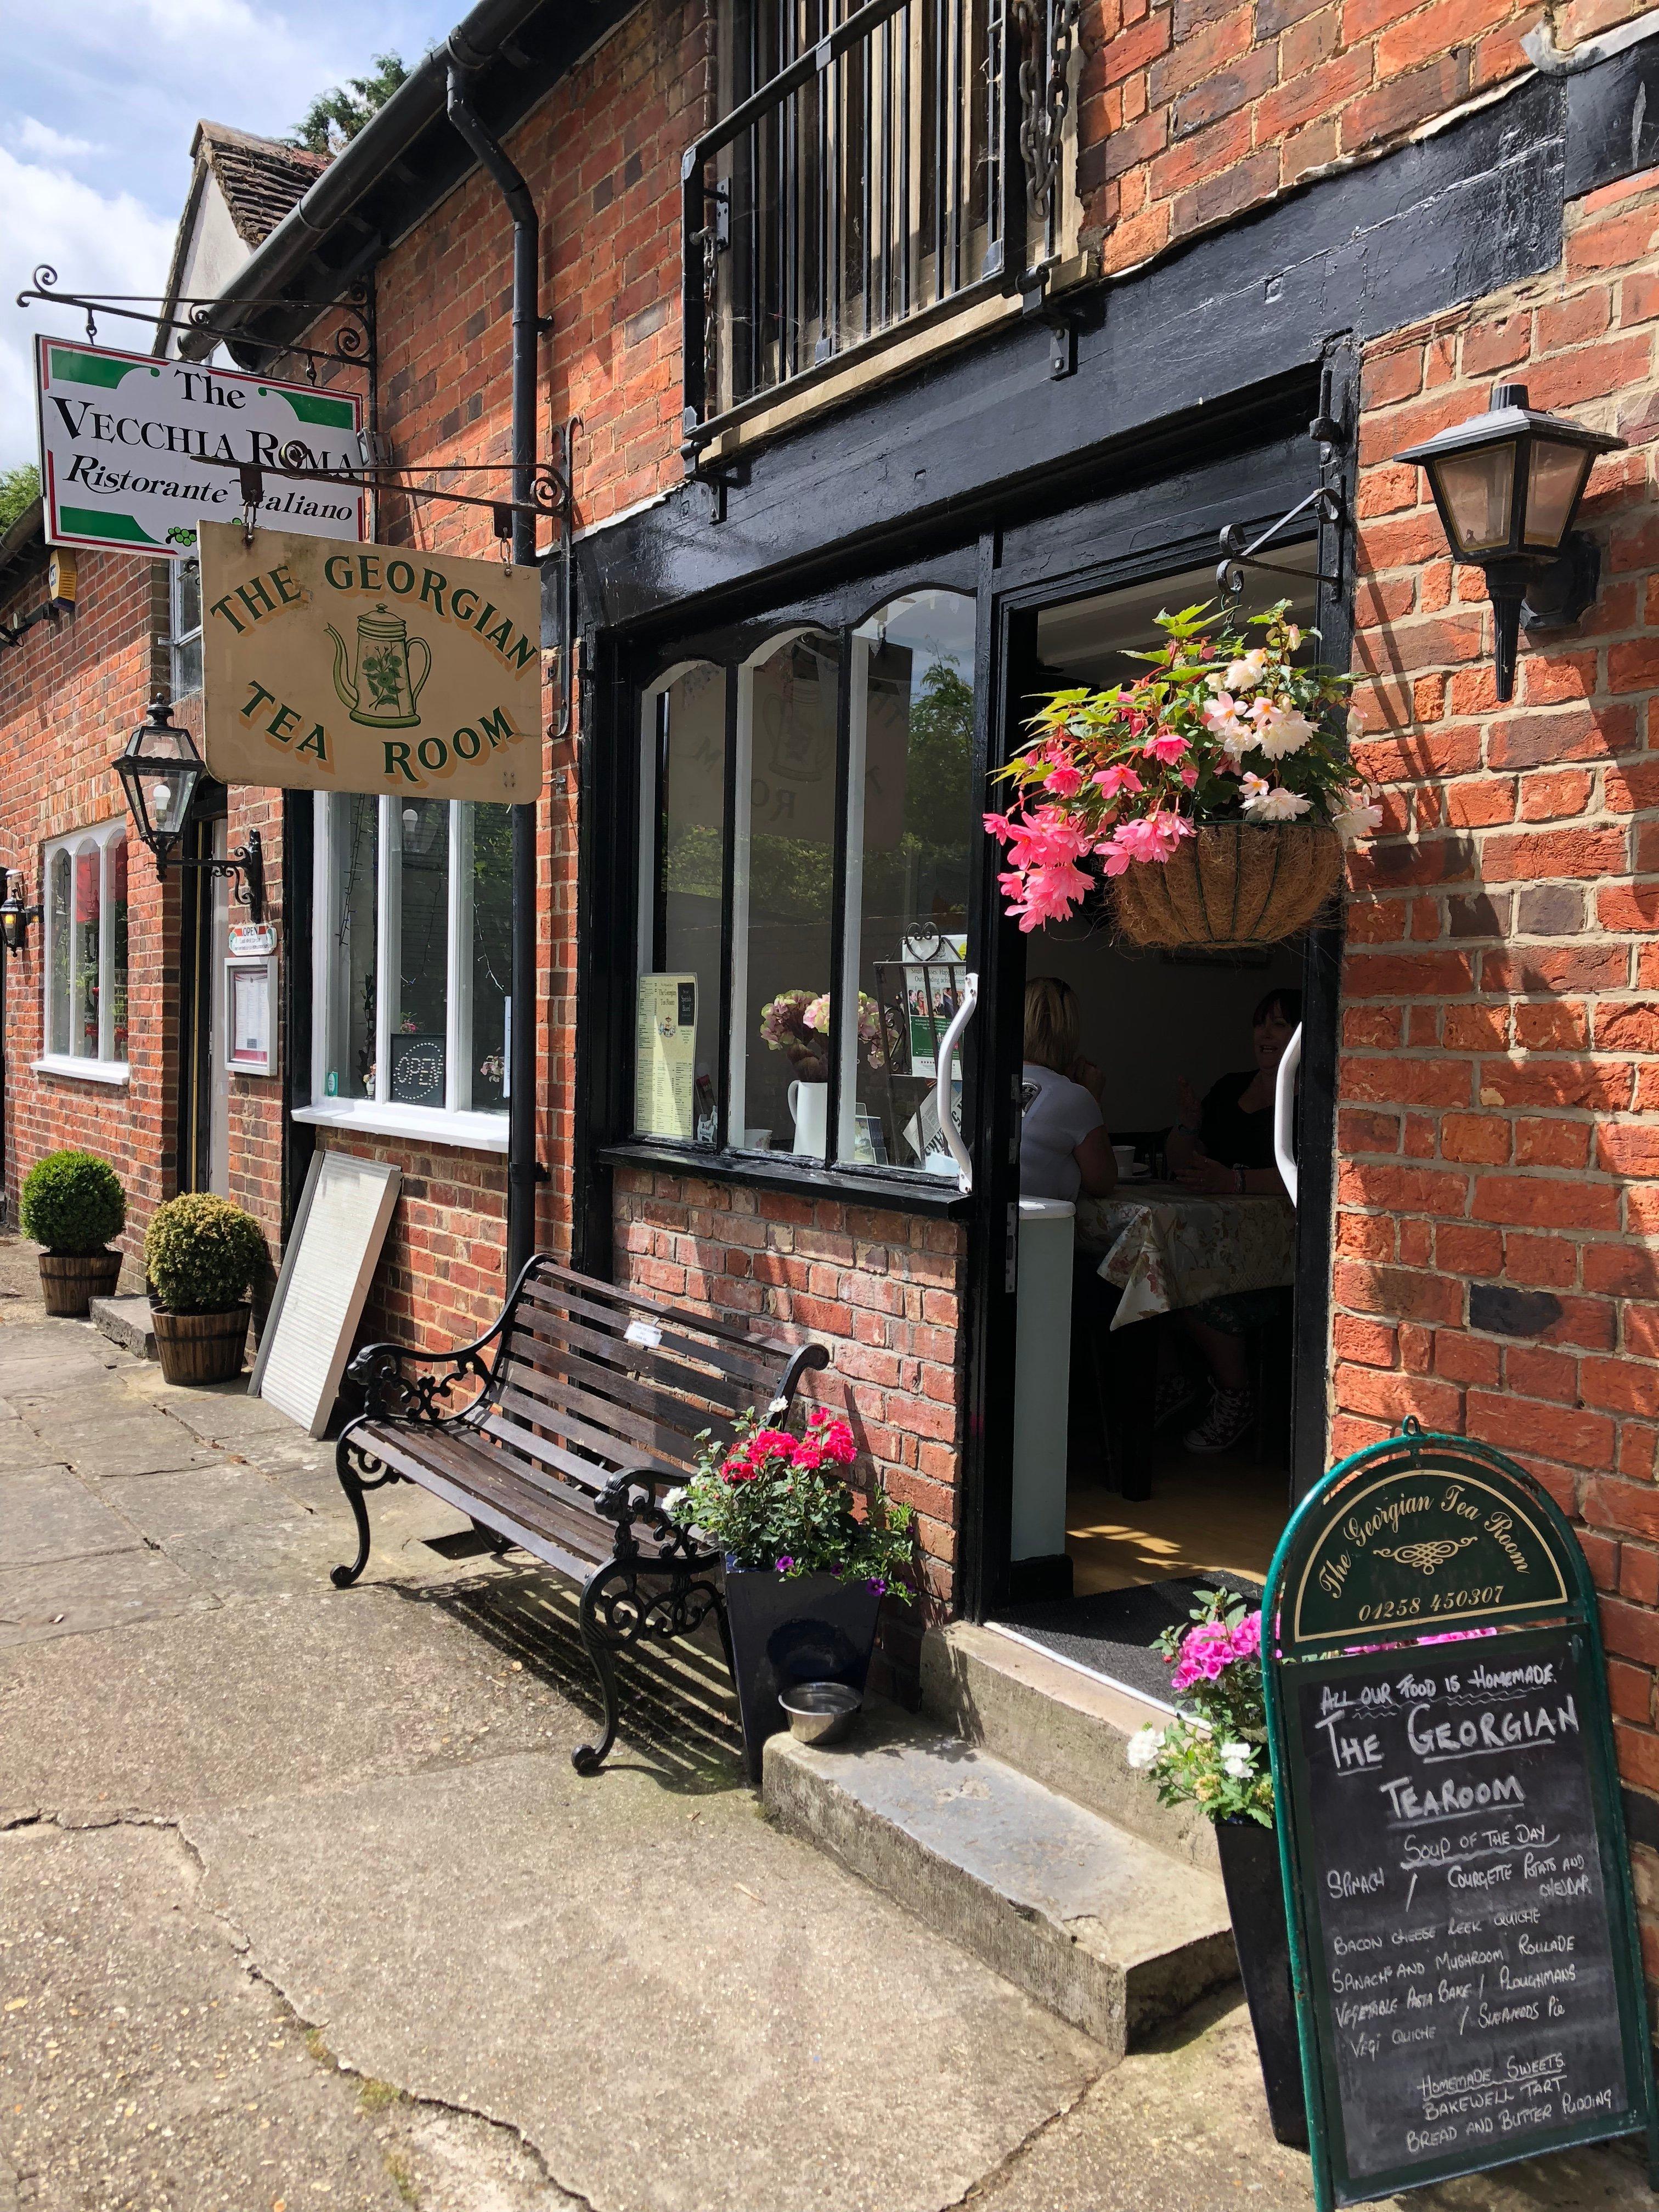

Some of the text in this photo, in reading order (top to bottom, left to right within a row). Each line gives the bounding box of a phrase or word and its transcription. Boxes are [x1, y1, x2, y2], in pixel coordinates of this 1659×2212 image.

[174, 369, 246, 409] The
[48, 396, 239, 462] VECCHIA
[63, 454, 352, 520] Ristorante taliano
[210, 555, 539, 671] THE GEORGIAN
[240, 680, 515, 782] TEA ROOM
[244, 927, 258, 936] OPEN
[1319, 1485, 1530, 1598] The Georgian Tea Room
[1359, 1585, 1504, 1622] 01258 450307
[1321, 1686, 1356, 1716] ALL
[1361, 1683, 1393, 1705] OUR
[1396, 1674, 1436, 1698] FOOD
[1444, 1675, 1460, 1692] IS
[1315, 1695, 1579, 1768] THE GEORGIAN
[1379, 1775, 1526, 1818] TEAROOM
[1404, 1824, 1545, 1862] SOUP OF THE DAY
[1327, 1867, 1384, 1898] SPINACH
[1448, 1864, 1511, 1889] COURGETTE
[1523, 1851, 1556, 1879] POTATO
[1563, 1854, 1584, 1872] AND
[1334, 1908, 1541, 1955] BACON CHEESE LEEK QUICHE
[1332, 1933, 1575, 1993] SPINACH AND MUSHROOM ROULADE
[1335, 1998, 1398, 2030] VEGETABLE
[1438, 1979, 1472, 2002] BAKE
[1500, 1964, 1576, 1990] PLOUGHMANS
[1392, 2025, 1436, 2044] QUICHE
[1417, 2068, 1492, 2097] HOMEMADE
[1423, 2075, 1567, 2121] BAKEWELL TART
[1406, 2126, 1457, 2153] BREAD
[1466, 2118, 1493, 2136] AND
[1498, 2103, 1551, 2131] BUTTER
